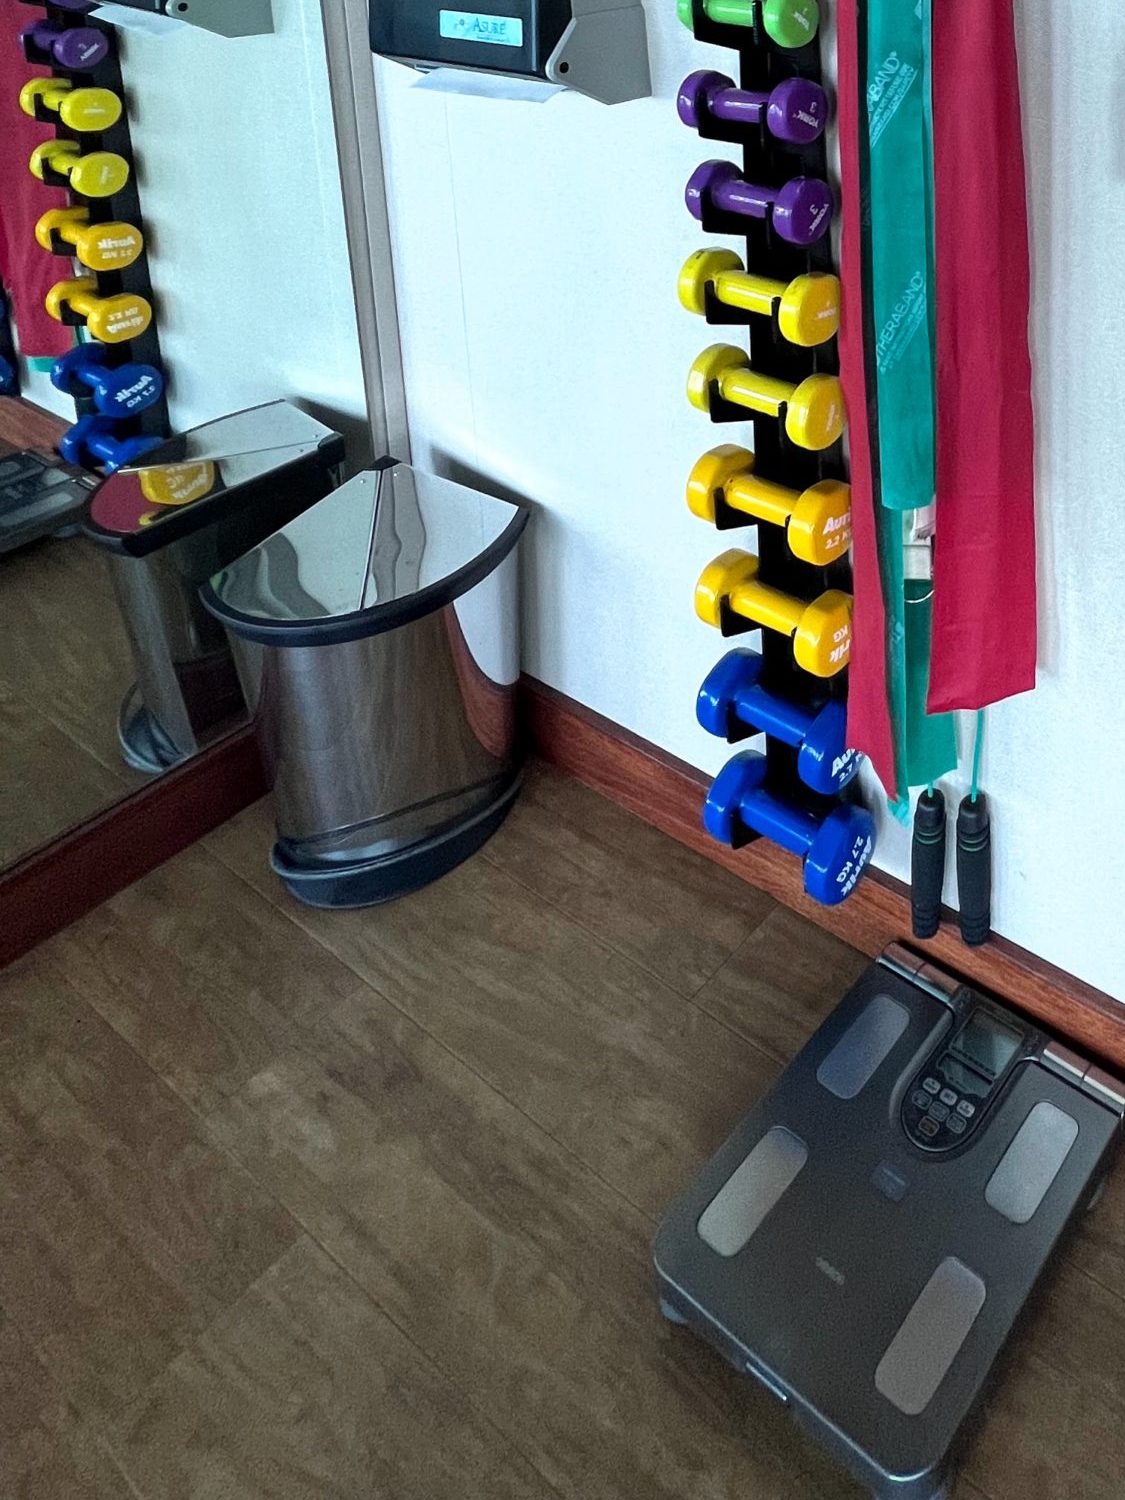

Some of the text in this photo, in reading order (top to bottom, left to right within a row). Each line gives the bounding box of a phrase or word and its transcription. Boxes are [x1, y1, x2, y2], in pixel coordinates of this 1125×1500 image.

[809, 101, 817, 113] 3
[796, 110, 819, 128] YORK
[809, 204, 819, 216] 3
[836, 835, 864, 883] 2.7 KG
[840, 835, 872, 896] Aurik
